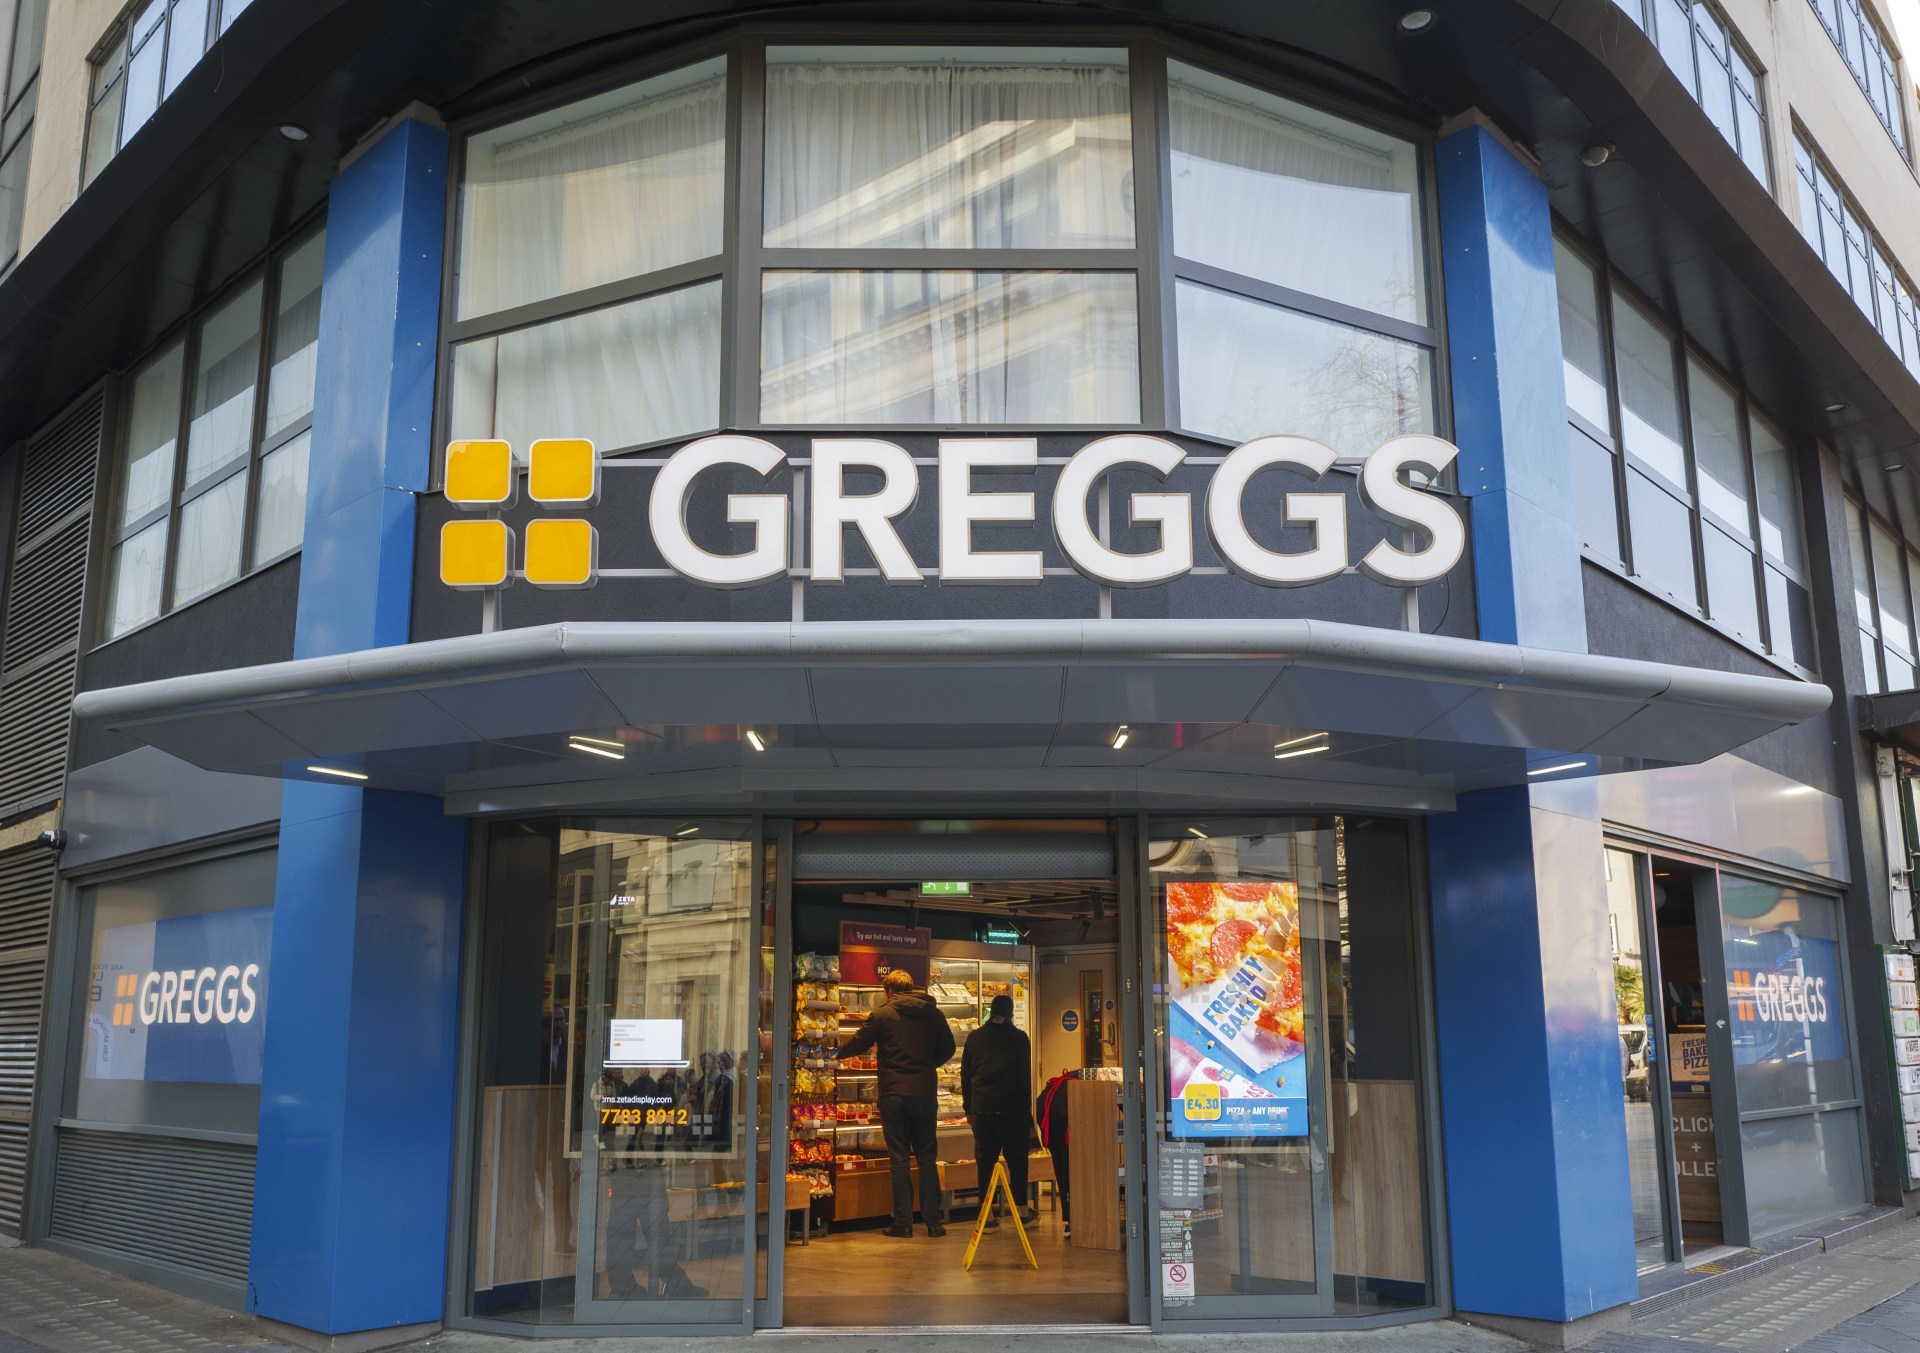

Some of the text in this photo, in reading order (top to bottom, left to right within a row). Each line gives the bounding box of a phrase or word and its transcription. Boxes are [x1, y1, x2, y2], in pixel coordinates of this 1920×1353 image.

[649, 434, 1467, 588] GREGGS
[856, 931, 864, 941] Try
[873, 932, 882, 940] hot
[892, 935, 904, 943] tasty
[904, 936, 917, 945] range
[877, 966, 891, 974] HOT
[139, 963, 260, 1026] GREGGS
[1202, 956, 1263, 1027] FRESHLY
[1754, 972, 1828, 1023] GREGGS
[1218, 985, 1268, 1041] BAKED
[1683, 1045, 1708, 1059] BAKE
[1684, 1056, 1708, 1070] PIZZ
[1187, 1098, 1219, 1110] £4.30
[1226, 1106, 1246, 1115] PIZZA
[1252, 1106, 1266, 1115] ANY
[601, 1108, 641, 1125] 7783
